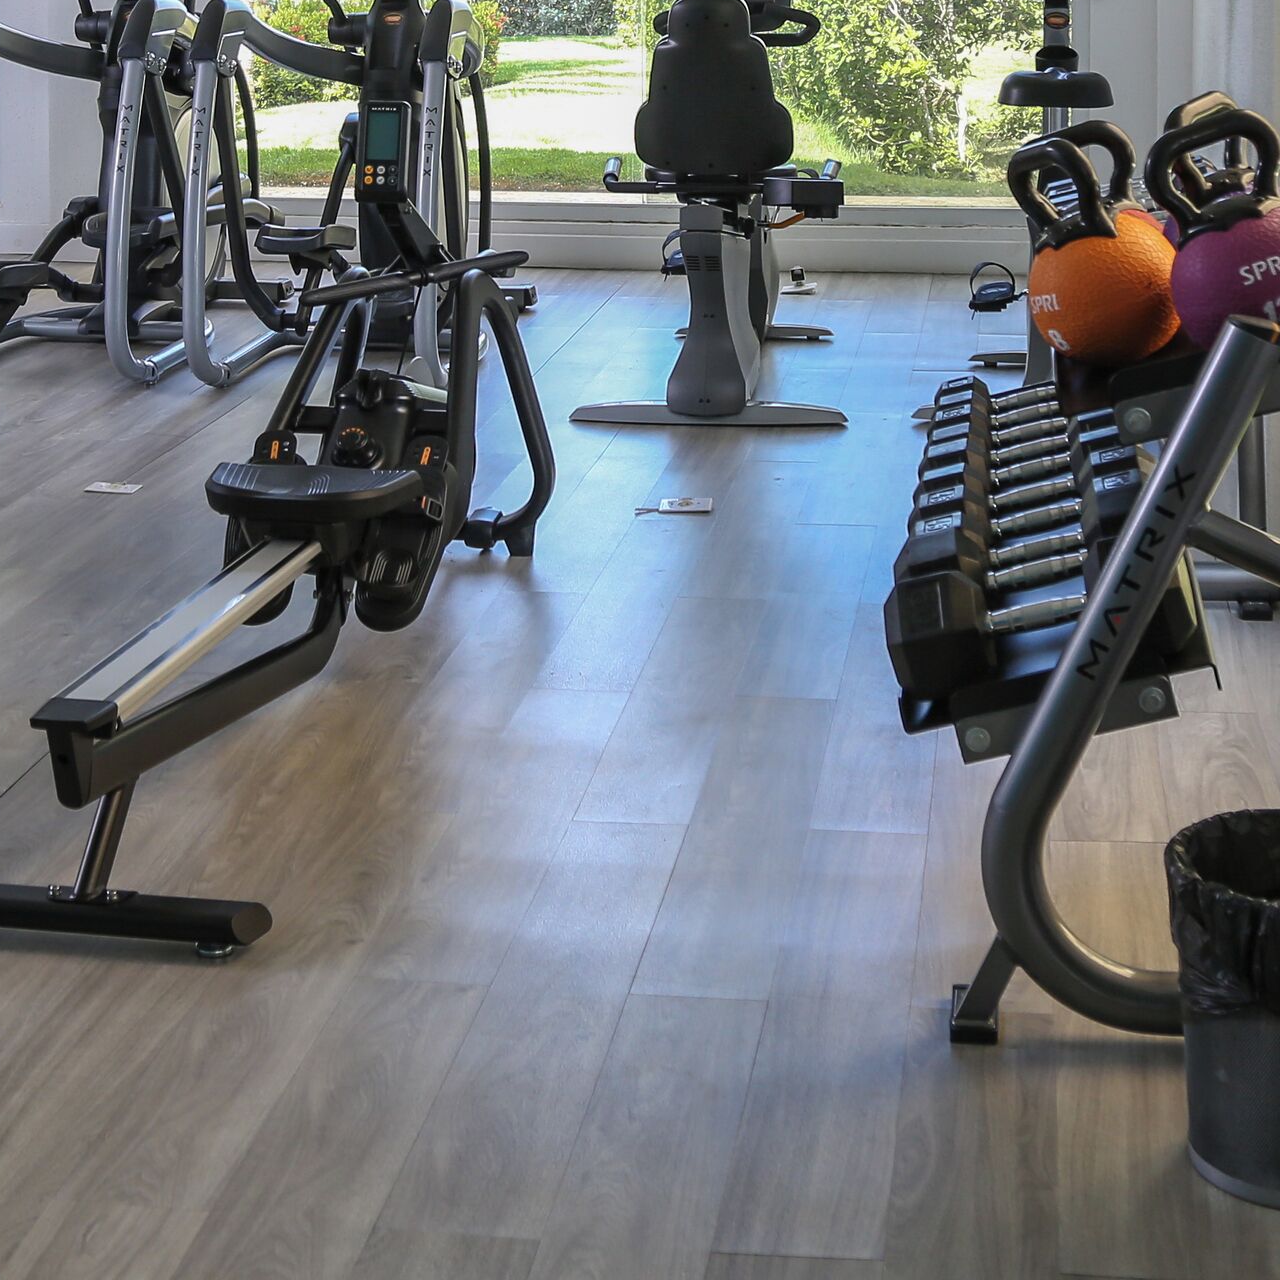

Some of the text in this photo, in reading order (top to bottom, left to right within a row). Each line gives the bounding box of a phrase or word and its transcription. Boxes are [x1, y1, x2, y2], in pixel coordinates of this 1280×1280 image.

[117, 104, 133, 173] MATRIX
[191, 106, 206, 176] MATRIX
[423, 106, 438, 177] MATRIX
[1030, 293, 1060, 314] SPRI
[1048, 329, 1071, 351] 8
[1076, 465, 1197, 681] MATRIX
